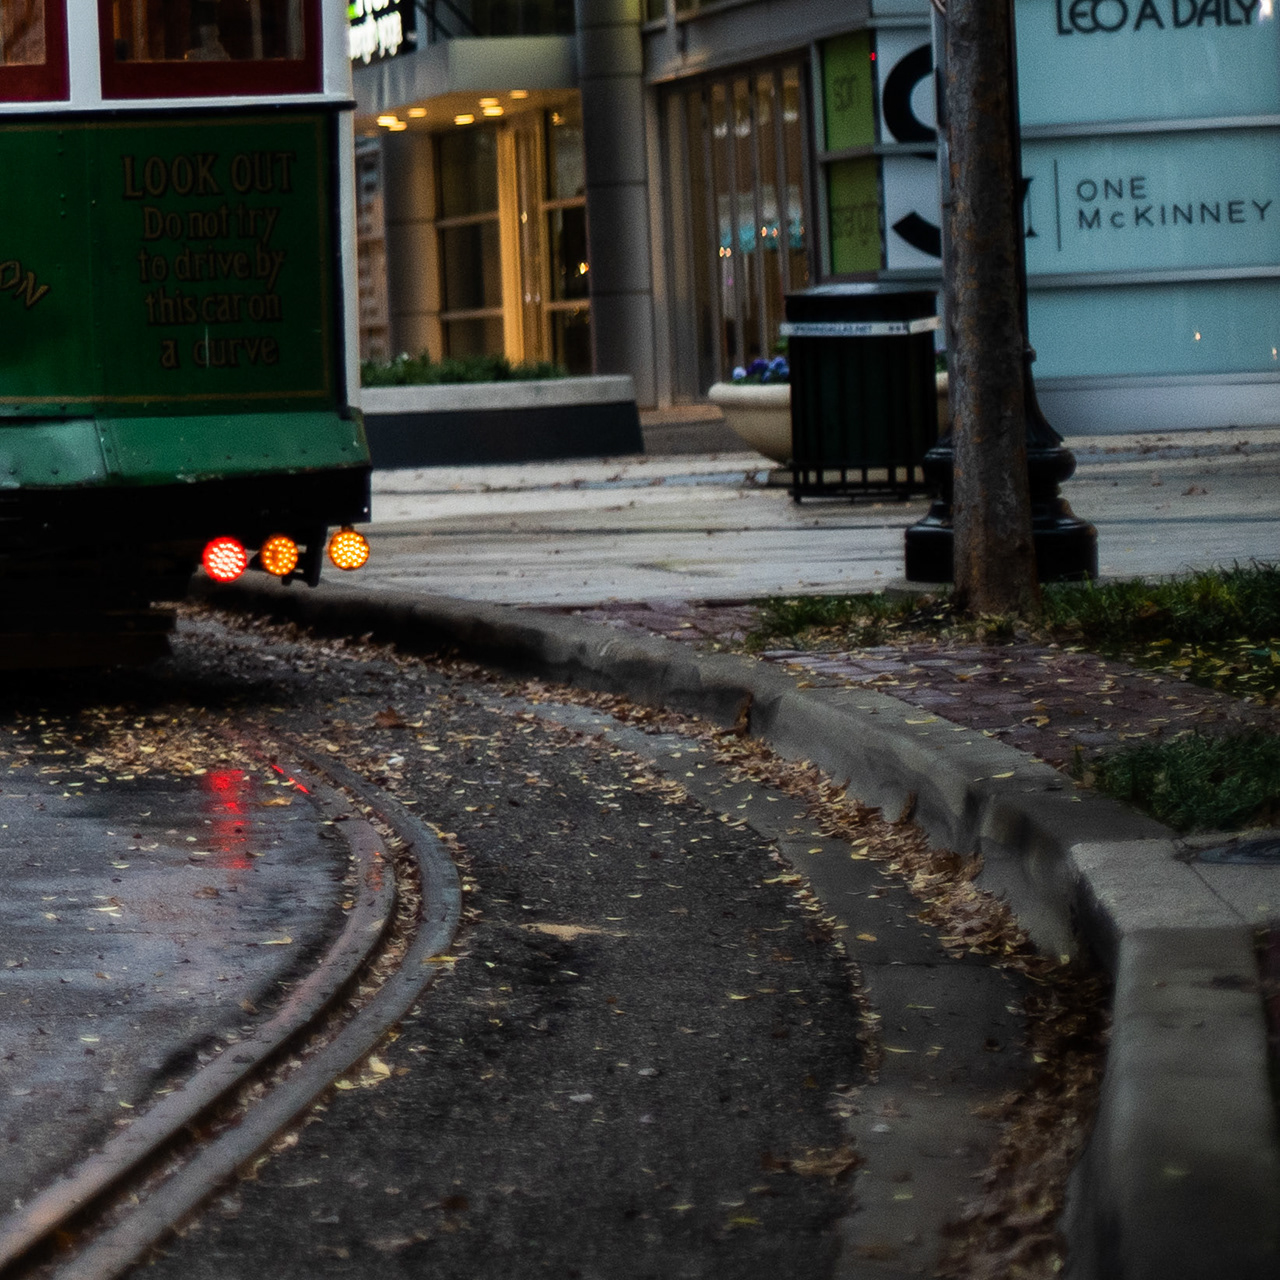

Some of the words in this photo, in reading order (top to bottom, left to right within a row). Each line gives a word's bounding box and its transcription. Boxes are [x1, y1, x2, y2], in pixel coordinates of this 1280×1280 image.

[122, 153, 223, 199] LOOK
[231, 151, 296, 193] OUT
[1076, 175, 1147, 203] ONE
[143, 205, 182, 241] Do
[188, 201, 228, 239] not
[236, 201, 280, 245] try
[1077, 199, 1273, 231] McKINNEY
[138, 248, 168, 283] to
[174, 243, 251, 281] drive
[256, 240, 286, 292] by
[146, 286, 198, 326] this
[202, 294, 245, 324] car
[248, 294, 282, 322] on
[160, 339, 179, 368] a
[193, 336, 280, 368] curve
